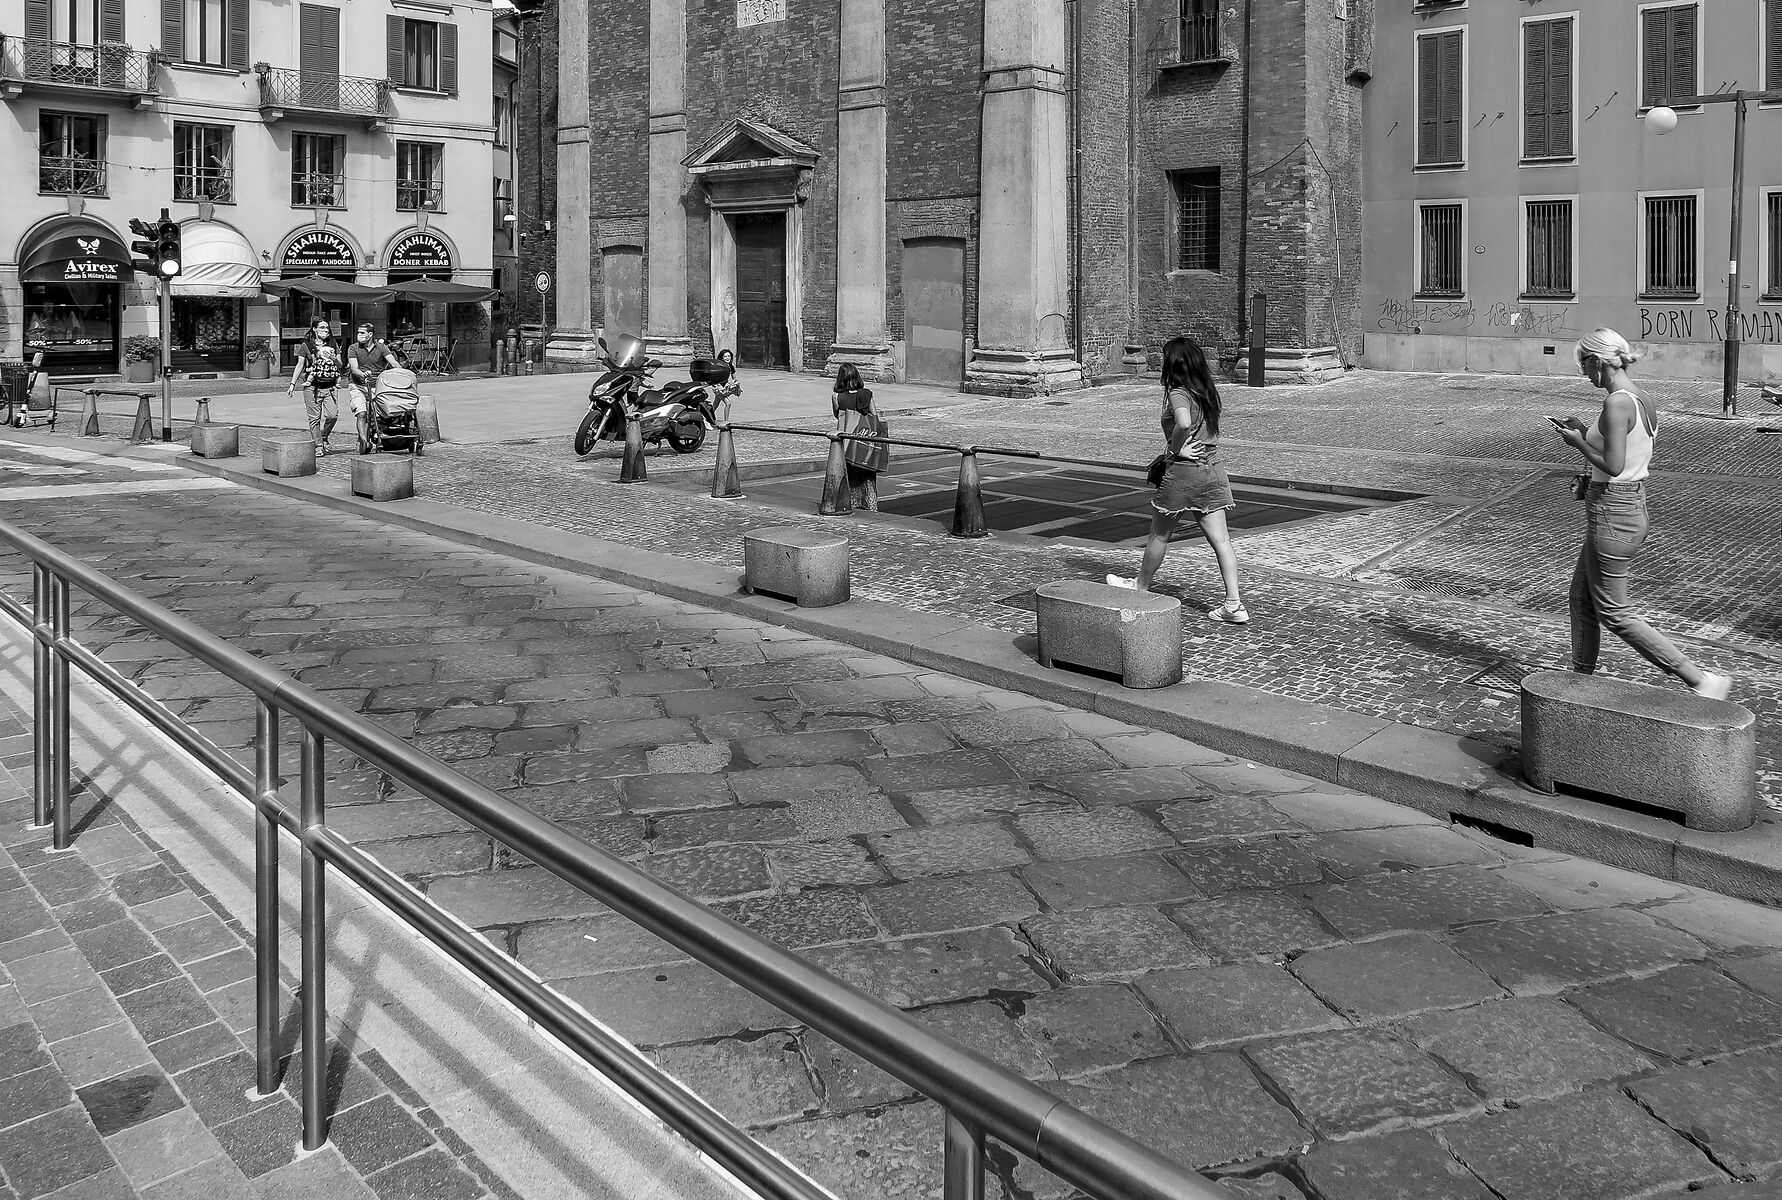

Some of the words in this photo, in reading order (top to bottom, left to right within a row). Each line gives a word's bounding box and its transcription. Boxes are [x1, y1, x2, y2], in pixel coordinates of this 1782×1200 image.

[287, 233, 351, 259] SHAHLIMAR
[394, 235, 447, 259] SHAHLIMAR
[64, 259, 117, 273] Avirex
[1640, 308, 1693, 340] BORN
